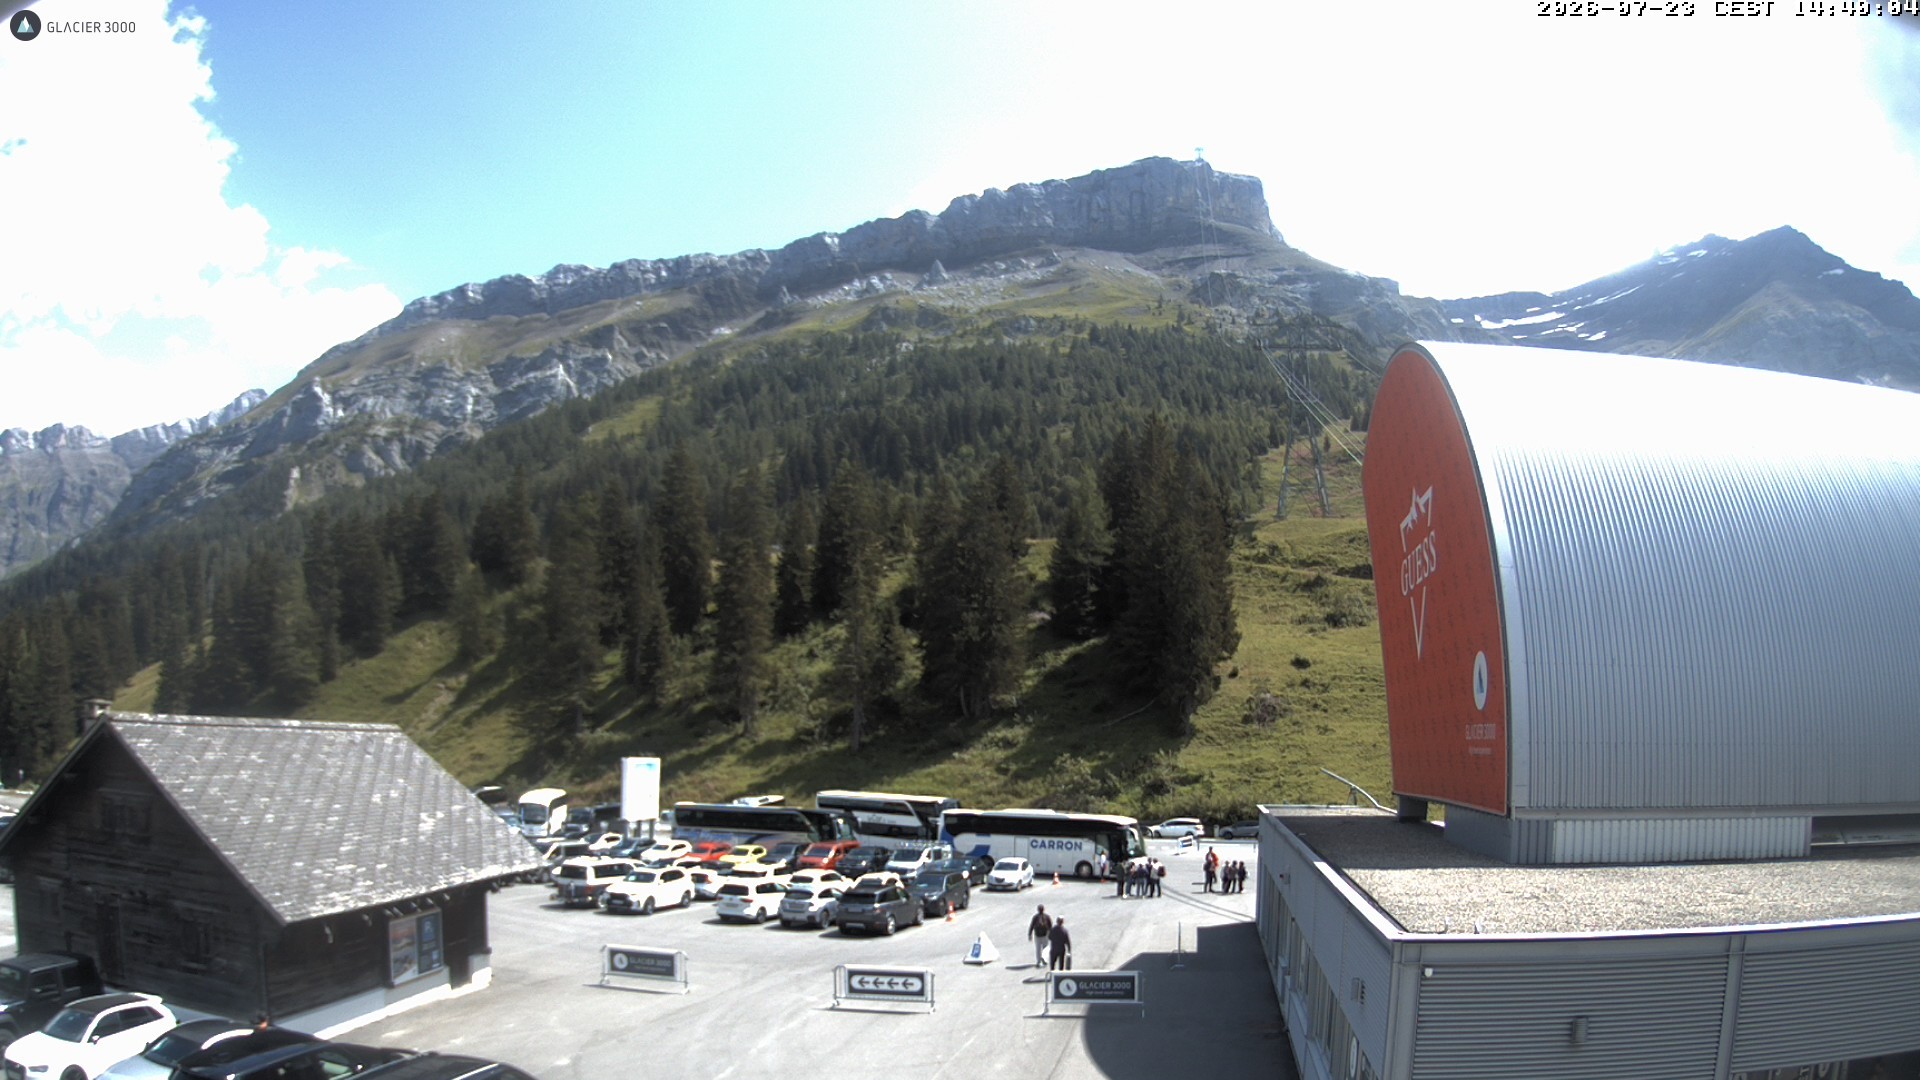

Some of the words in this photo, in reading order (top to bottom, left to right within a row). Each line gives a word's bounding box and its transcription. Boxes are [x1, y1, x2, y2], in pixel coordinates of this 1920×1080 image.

[1400, 529, 1437, 596] GUESS
[1029, 838, 1083, 852] CARRON
[1079, 982, 1111, 990] GLACIER
[1112, 982, 1131, 990] 3000
